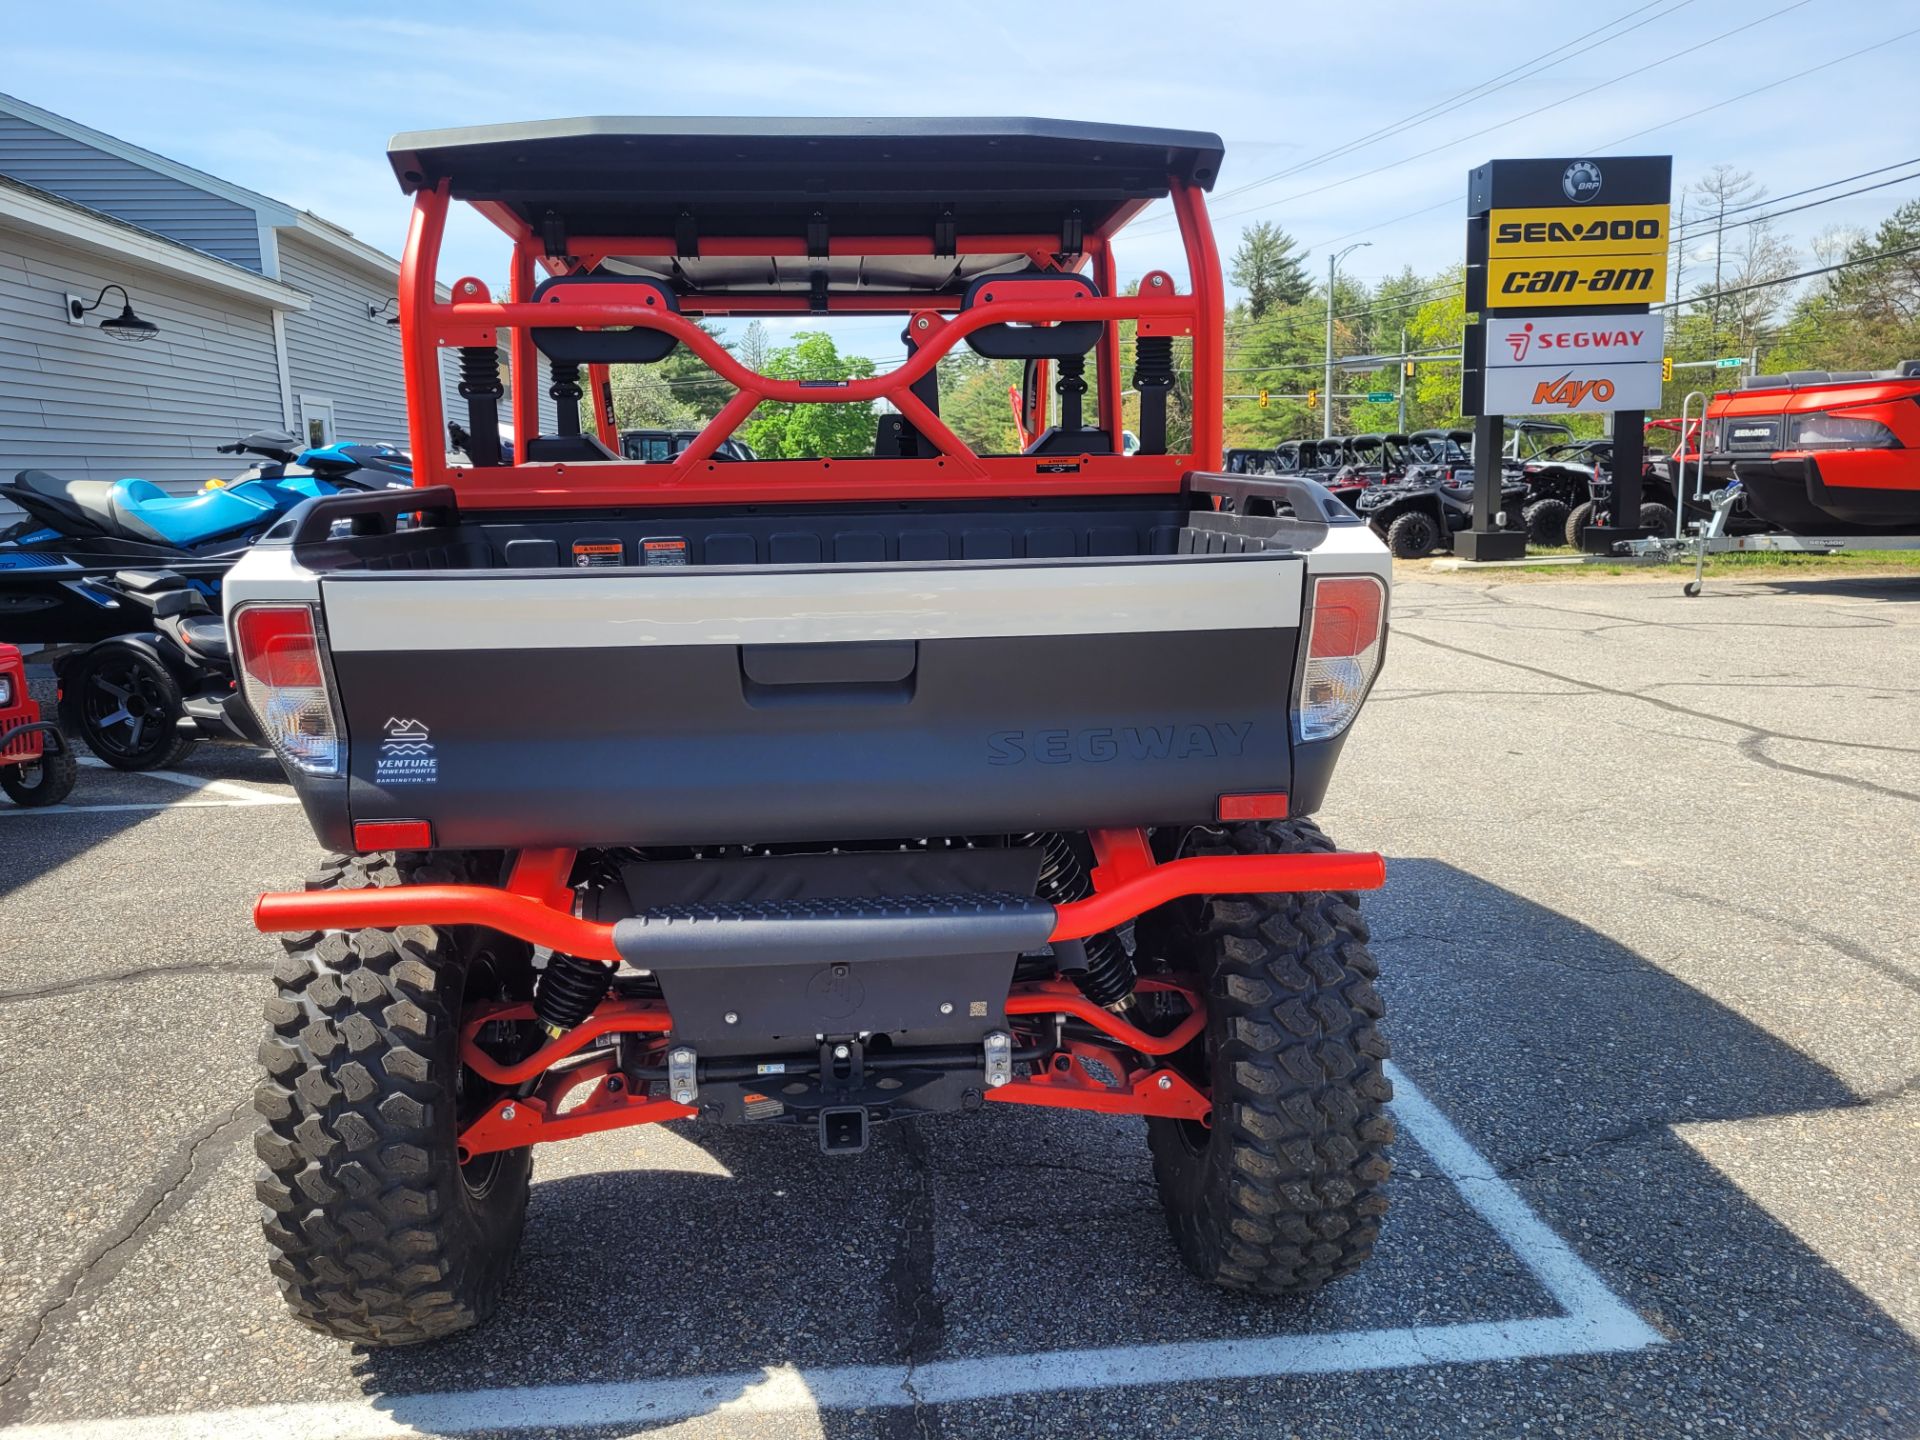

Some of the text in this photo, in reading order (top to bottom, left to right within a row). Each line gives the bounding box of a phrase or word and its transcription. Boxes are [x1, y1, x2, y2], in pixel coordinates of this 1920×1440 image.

[1578, 182, 1600, 191] BRP
[1537, 330, 1645, 349] SEGWAY
[986, 721, 1254, 766] SEGWAY
[377, 759, 437, 768] VENTURE
